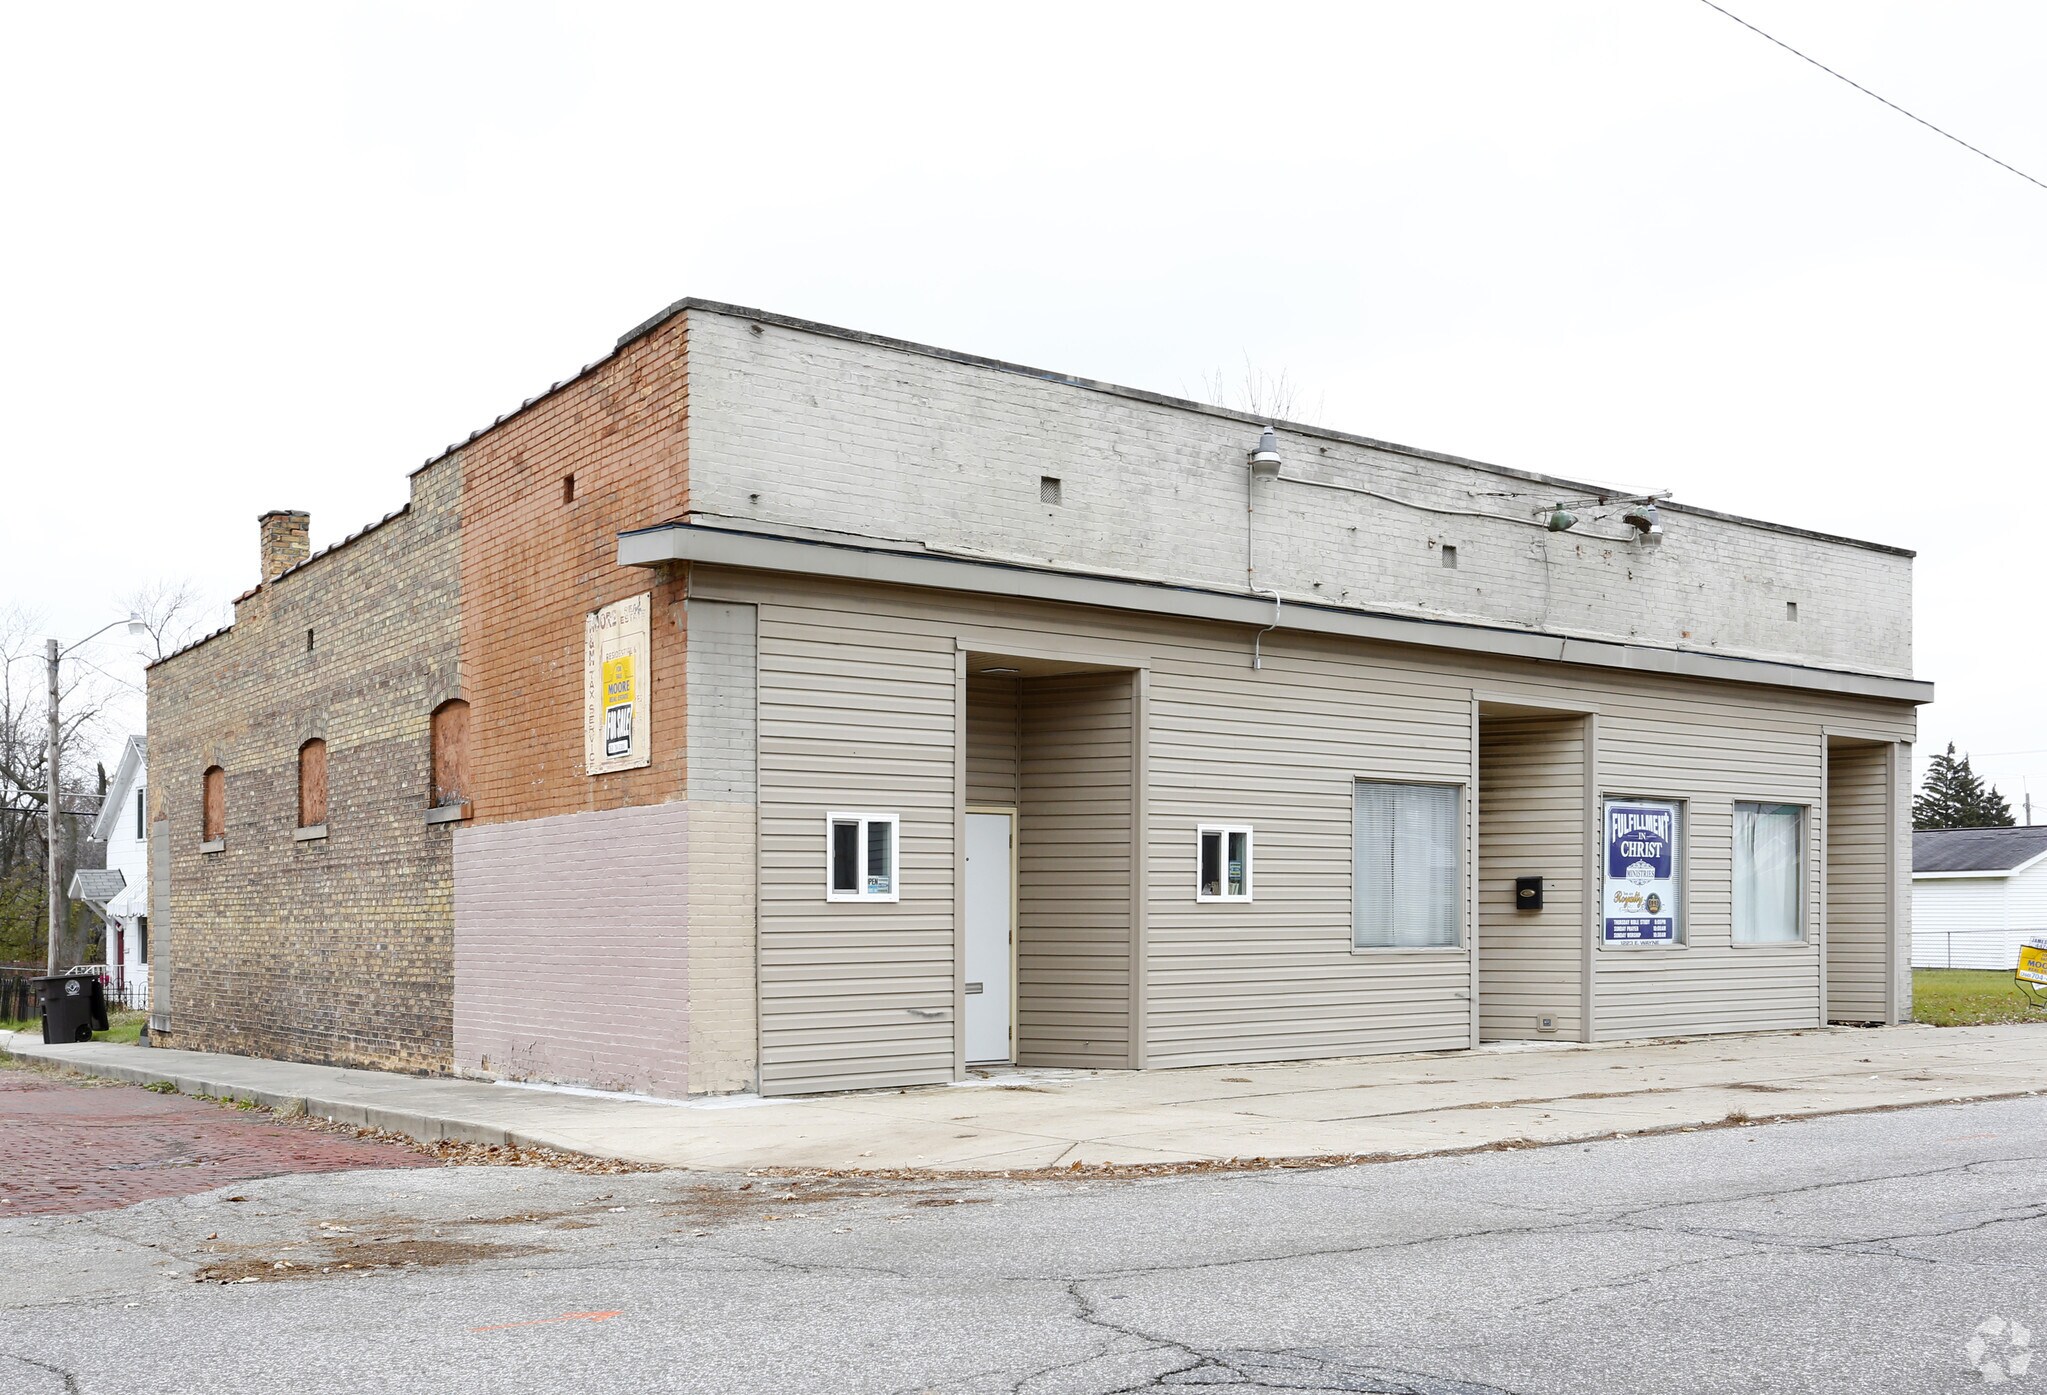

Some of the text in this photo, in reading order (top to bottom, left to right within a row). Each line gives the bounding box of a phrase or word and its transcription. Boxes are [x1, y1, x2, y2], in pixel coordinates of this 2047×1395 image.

[608, 680, 630, 695] MOORE
[617, 707, 631, 739] SALE
[1612, 812, 1669, 843] FULFILLMENT
[1638, 832, 1646, 840] IN
[1621, 841, 1663, 858] CHRIST
[2028, 960, 2047, 969] MOO
